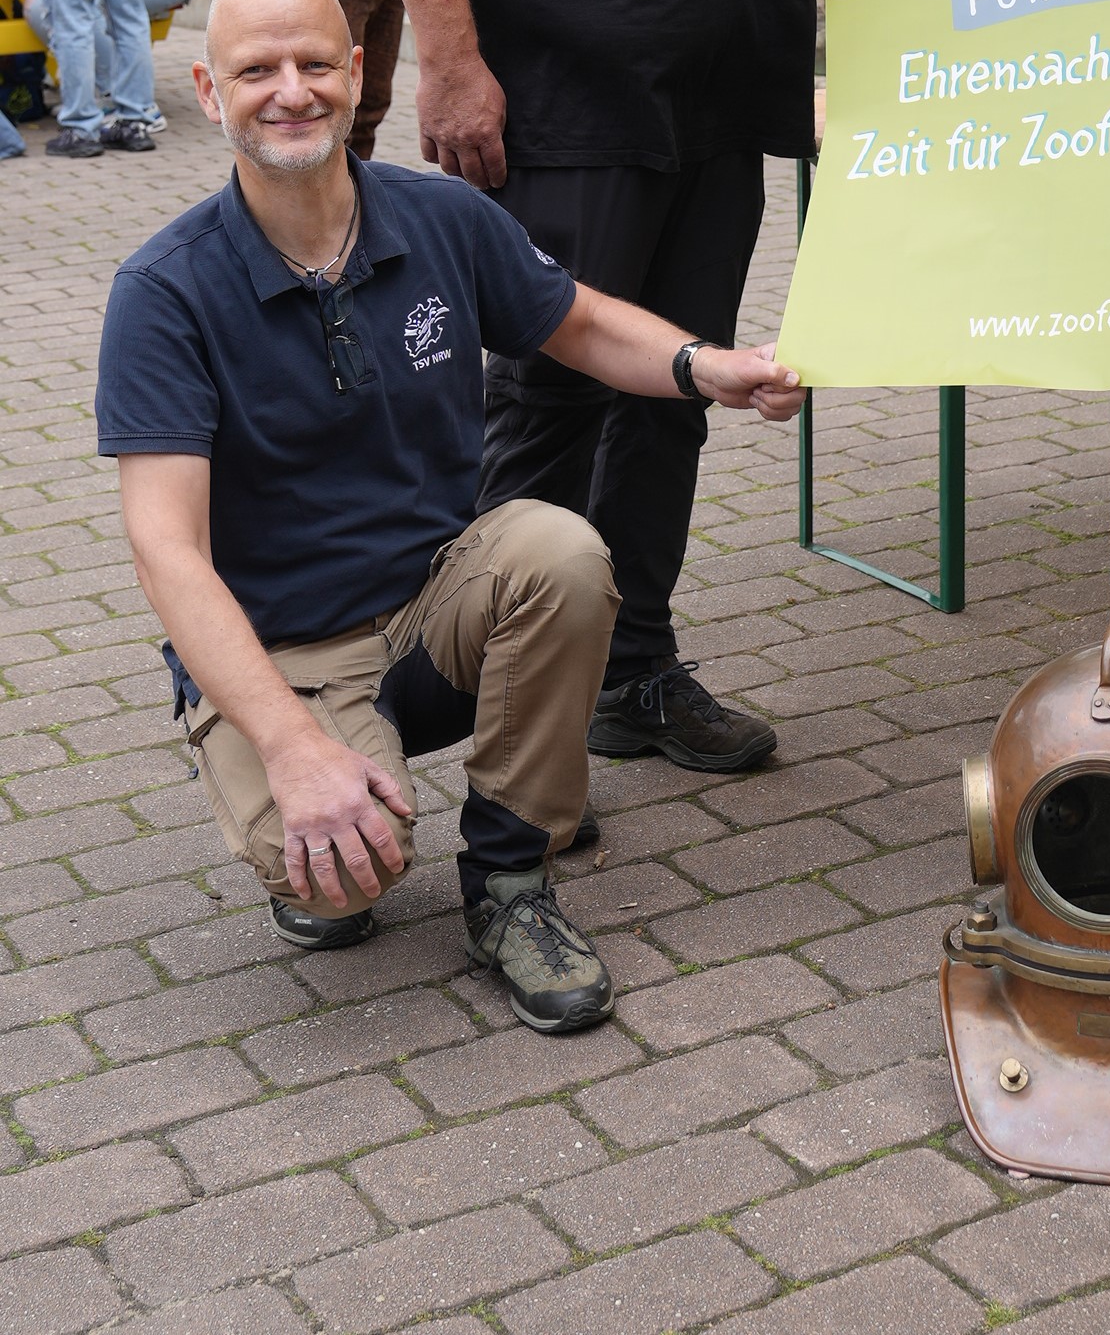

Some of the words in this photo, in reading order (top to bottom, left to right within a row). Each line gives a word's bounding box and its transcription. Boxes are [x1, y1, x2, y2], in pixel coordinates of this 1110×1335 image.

[846, 129, 934, 180] Zeit
[946, 119, 1010, 173] für
[412, 356, 431, 372] TSV
[431, 348, 452, 365] NRW
